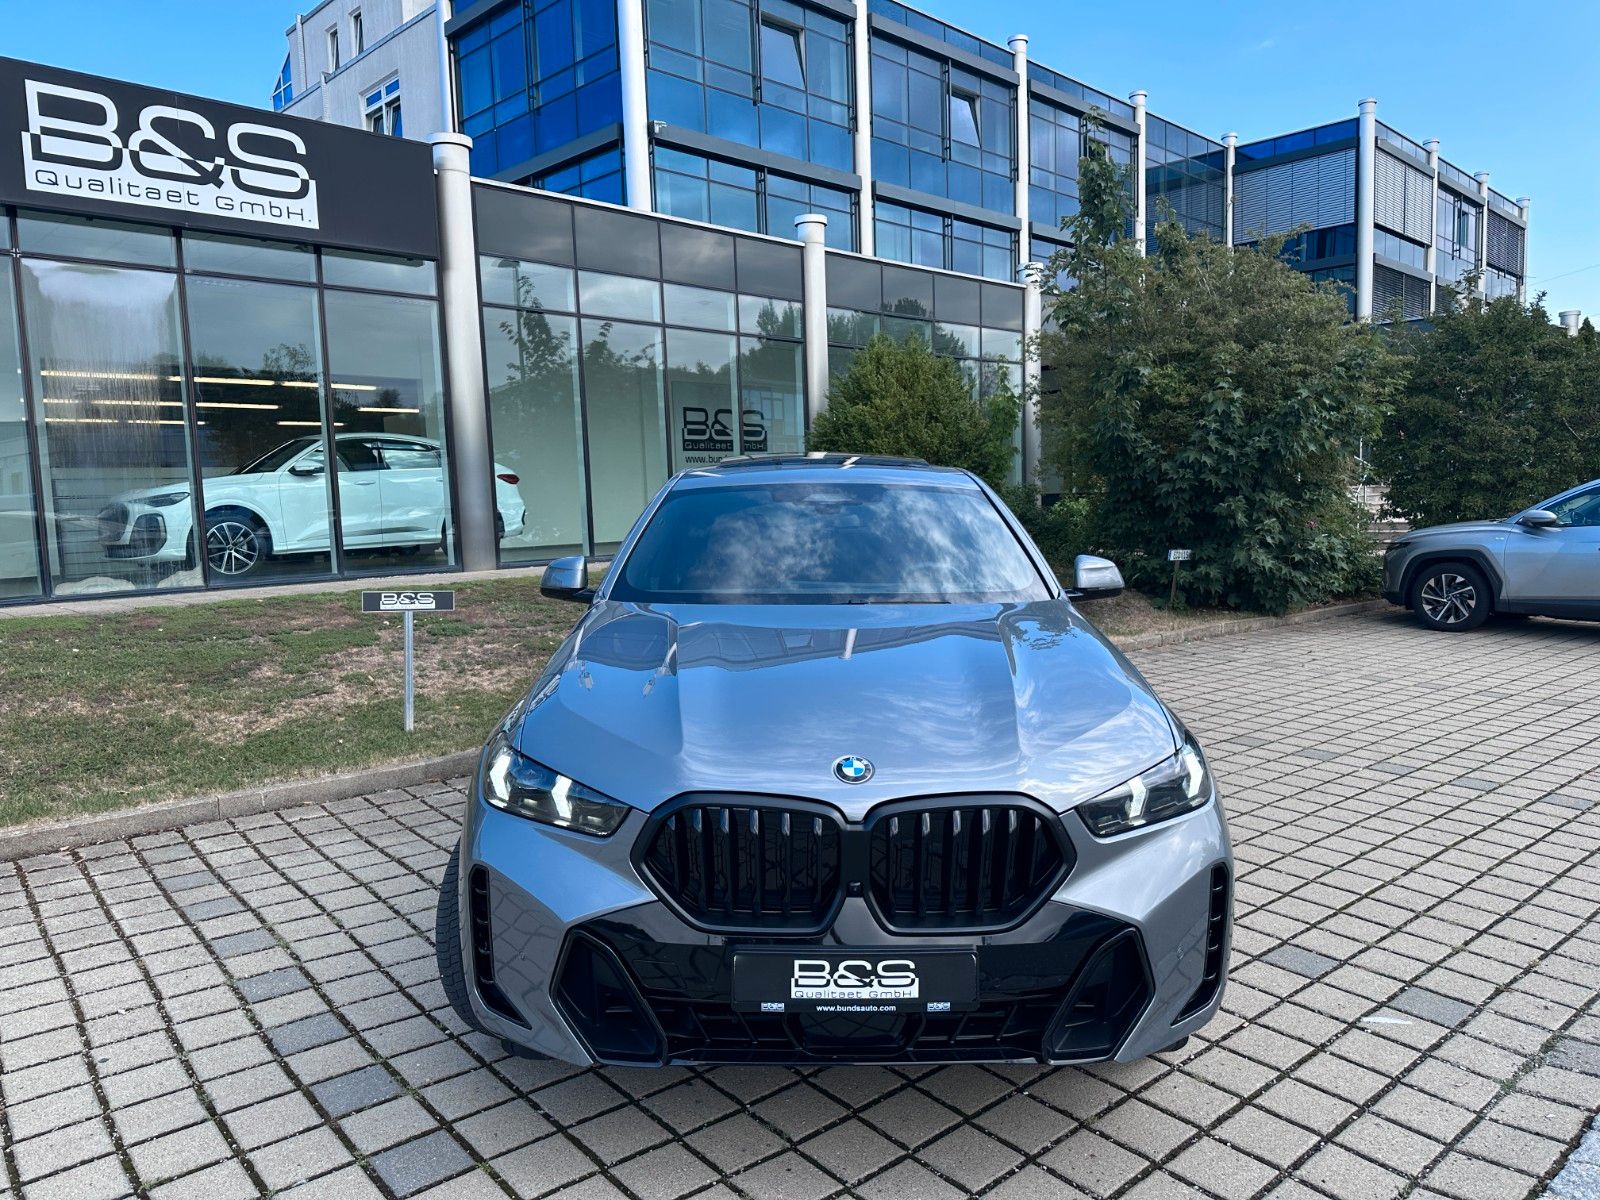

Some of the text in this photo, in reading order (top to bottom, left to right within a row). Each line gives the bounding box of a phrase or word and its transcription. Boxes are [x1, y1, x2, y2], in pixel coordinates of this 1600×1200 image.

[24, 79, 310, 200] B&S
[35, 169, 200, 206] Qualitaet
[683, 407, 766, 440] B&S
[684, 441, 732, 449] Qualitaet
[381, 592, 434, 605] B&S
[793, 959, 916, 988] B&S
[794, 990, 862, 998] Qualitaet
[816, 1004, 896, 1012] www.bundsauto.com
